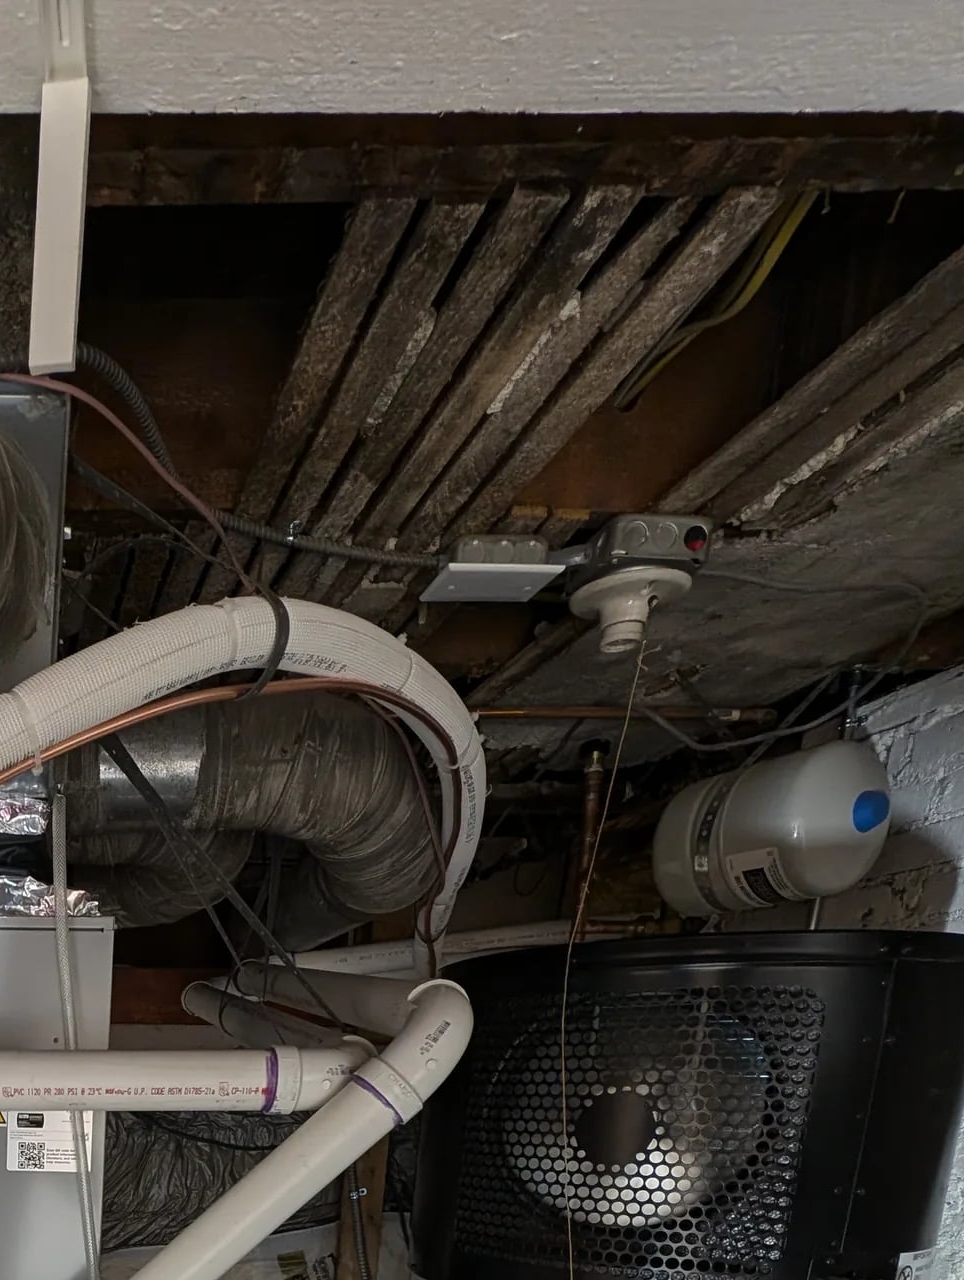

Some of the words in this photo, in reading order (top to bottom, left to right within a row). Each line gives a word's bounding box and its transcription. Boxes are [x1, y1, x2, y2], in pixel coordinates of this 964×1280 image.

[13, 1087, 24, 1096] PVC
[27, 1087, 41, 1096] 1120
[43, 1087, 52, 1096] PR
[67, 1087, 78, 1096] PSI
[150, 1087, 165, 1096] CODE
